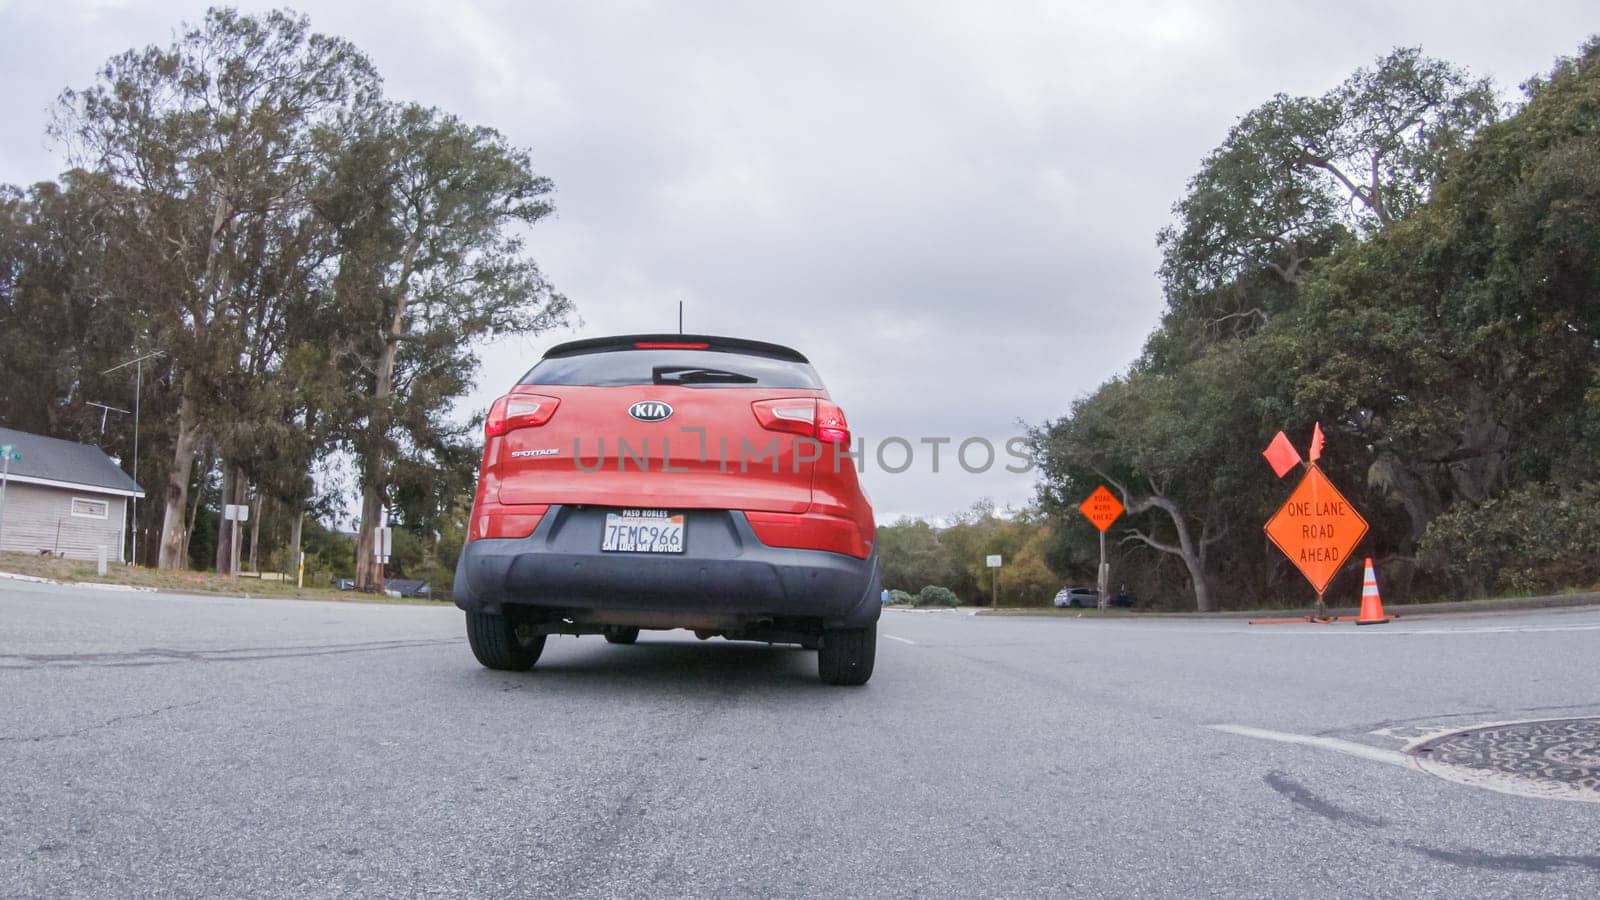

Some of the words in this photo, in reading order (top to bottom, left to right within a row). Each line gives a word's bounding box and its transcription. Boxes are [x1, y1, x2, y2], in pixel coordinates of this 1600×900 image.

[635, 404, 666, 417] KIA
[622, 510, 640, 518] PASO
[642, 510, 668, 518] ROBLES
[1288, 503, 1311, 517] ONE
[1316, 502, 1345, 516] LANE
[608, 525, 680, 546] 7FMC966
[1302, 524, 1334, 539] ROAD
[603, 542, 617, 551] SAN
[619, 543, 635, 552] LUIS
[636, 544, 650, 552] BAY
[652, 544, 682, 553] MOTORS
[1300, 547, 1339, 562] AHEAD
